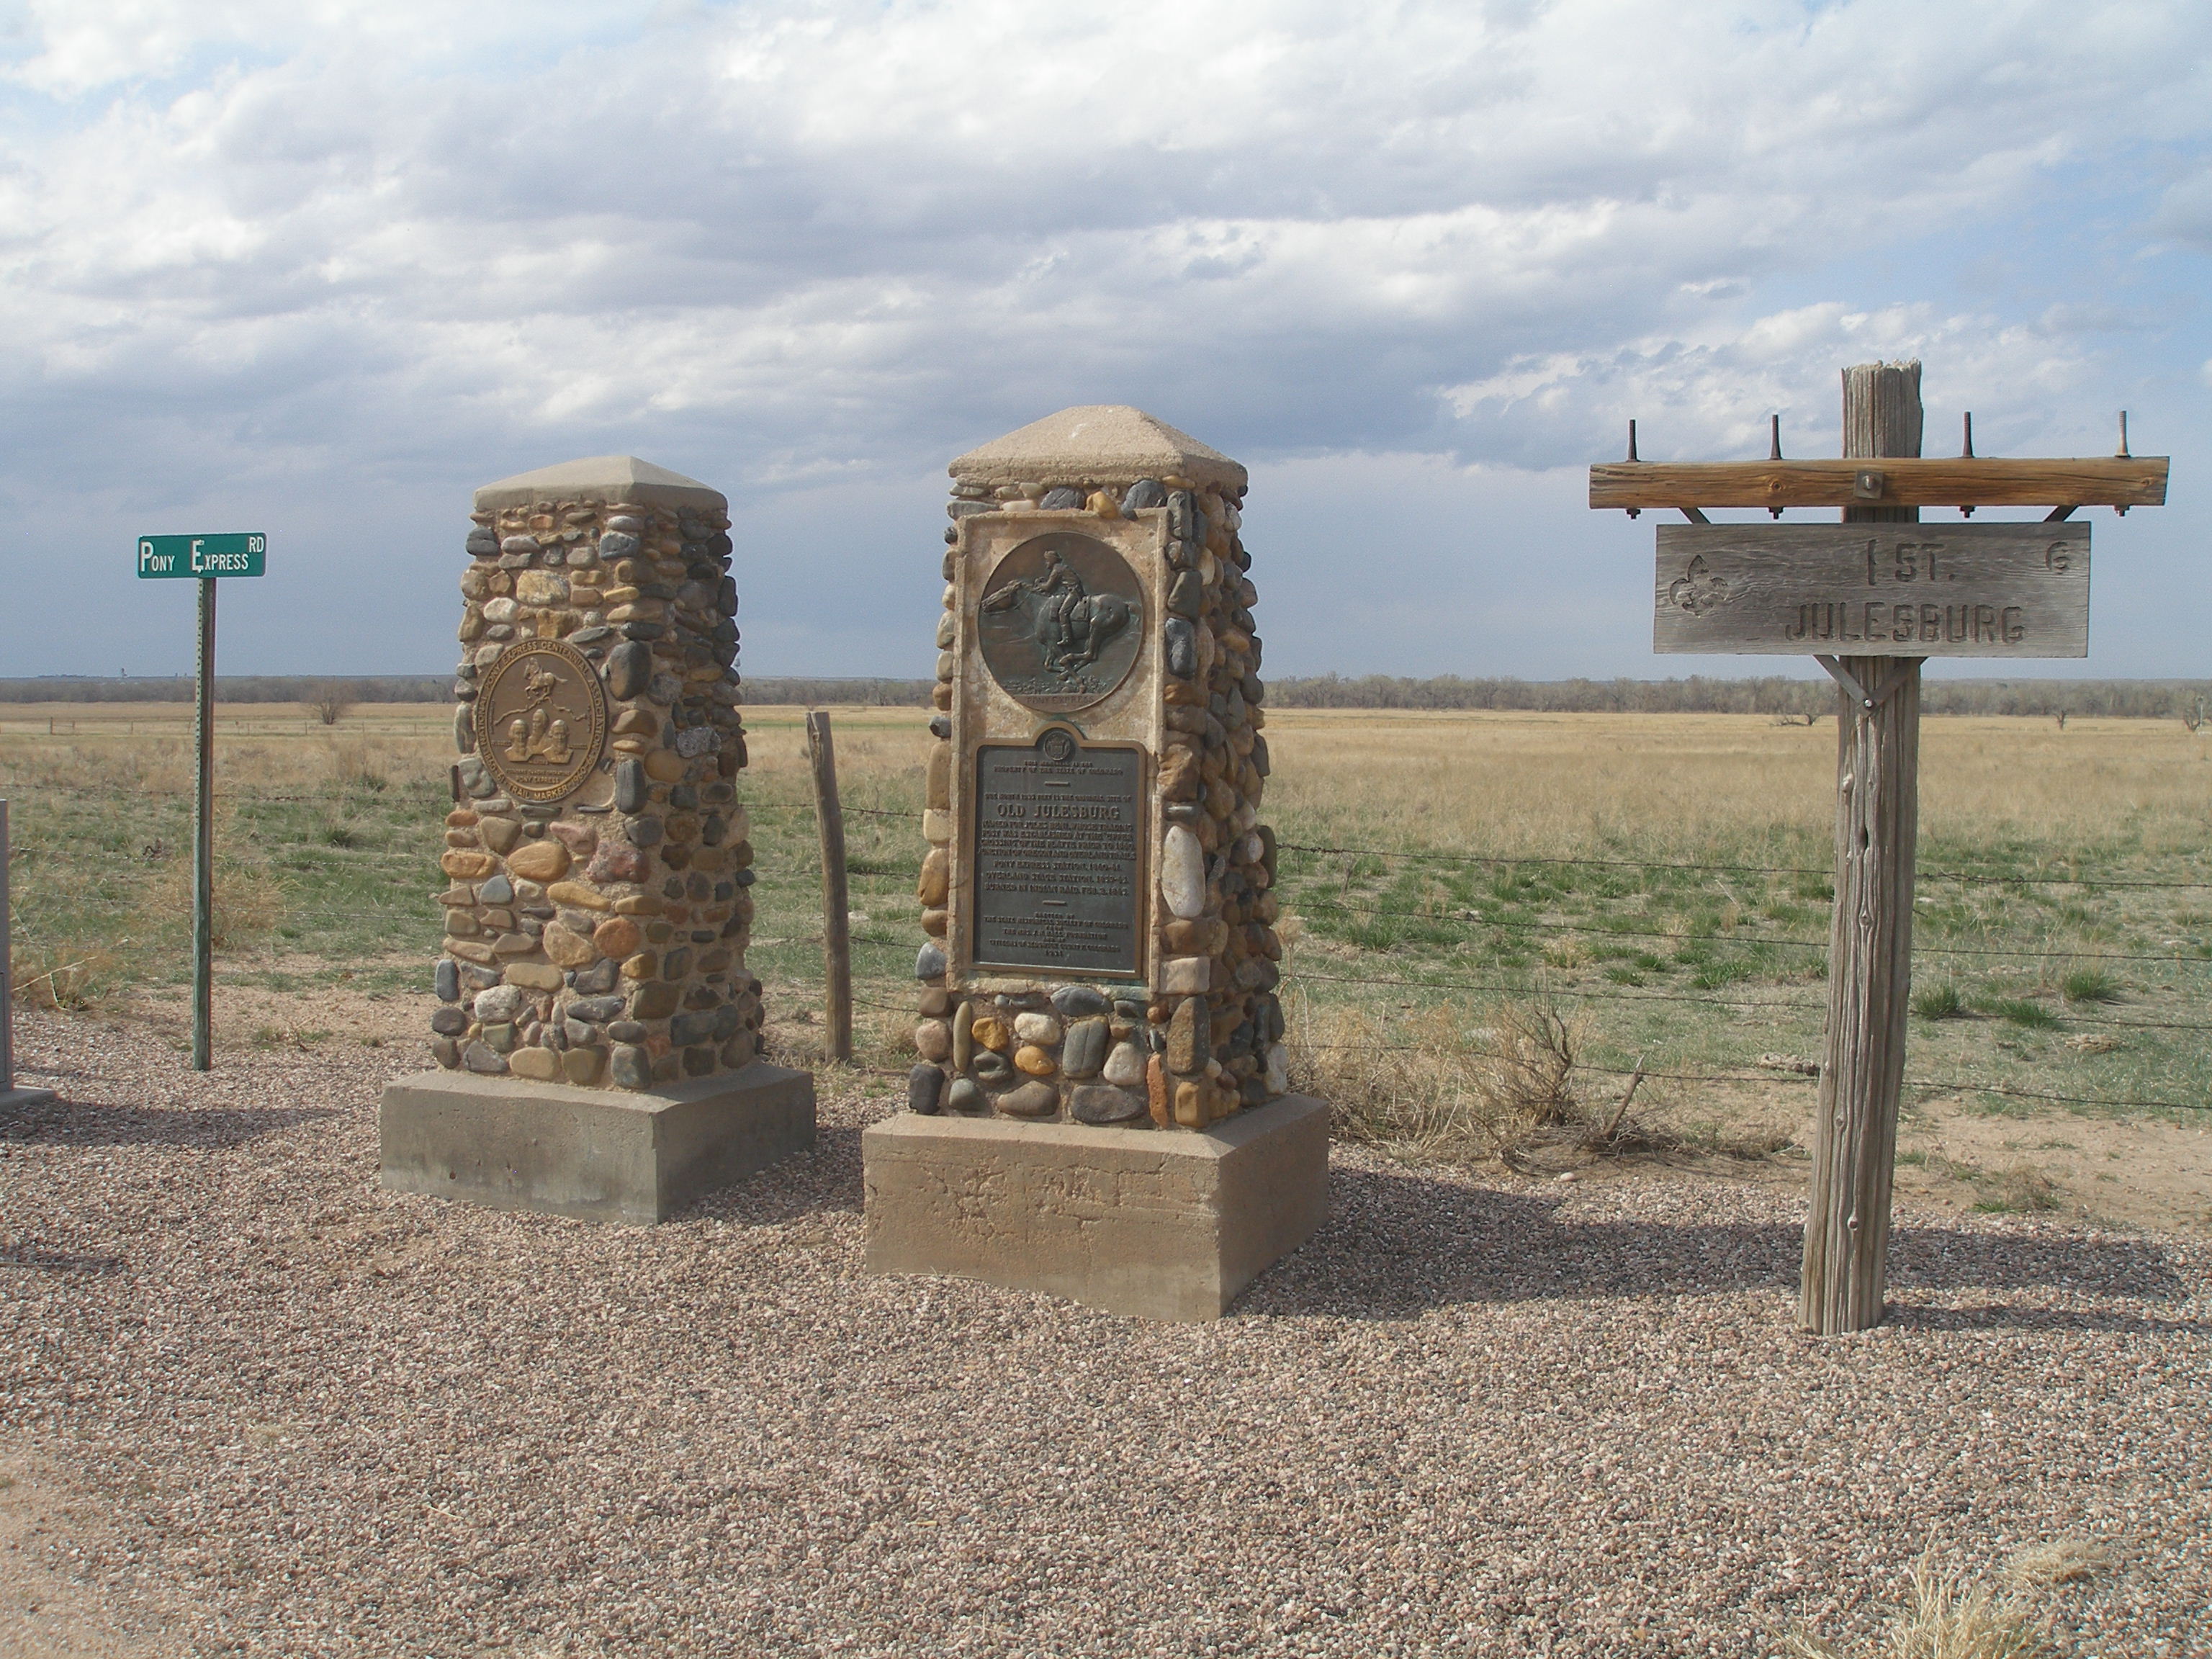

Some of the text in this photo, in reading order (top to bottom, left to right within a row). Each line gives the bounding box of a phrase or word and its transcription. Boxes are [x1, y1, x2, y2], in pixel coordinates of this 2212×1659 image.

[140, 536, 264, 573] PONY EXPRESS RD
[2045, 541, 2072, 575] 6
[1785, 601, 2026, 644] JULESBURG
[485, 663, 502, 691] PONY
[502, 641, 538, 665] EXPRESS
[541, 641, 590, 675] CENTENNIAL
[587, 679, 603, 750] ASSOCIATION
[1051, 696, 1094, 705] EXPRESS
[508, 783, 569, 801] TRAIL MARKER
[997, 803, 1120, 821] OLD JULESBURG
